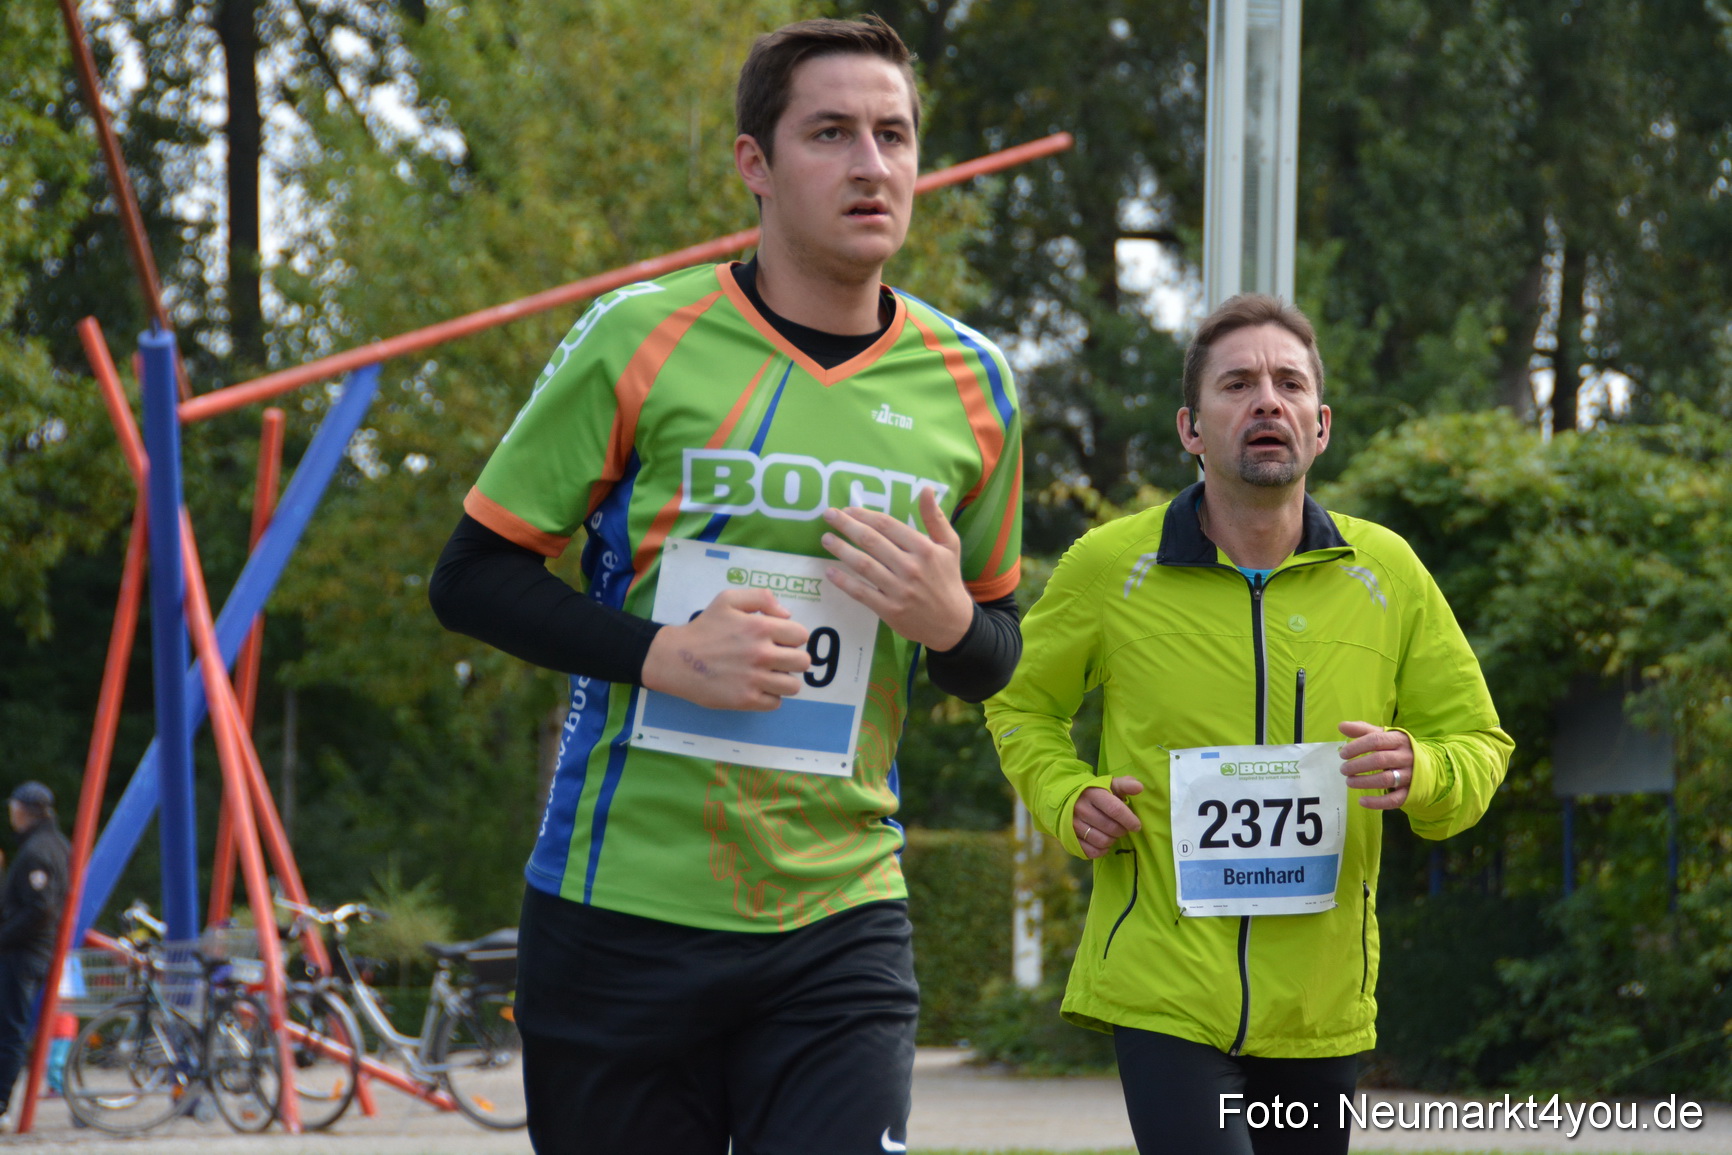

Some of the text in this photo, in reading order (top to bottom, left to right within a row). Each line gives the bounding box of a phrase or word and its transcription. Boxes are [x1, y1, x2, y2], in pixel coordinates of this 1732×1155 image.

[680, 448, 949, 536] BOCK
[749, 570, 822, 595] BOCK
[1238, 760, 1300, 776] BOCK
[1198, 797, 1323, 849] 2375
[1182, 844, 1189, 853] D
[1223, 866, 1305, 885] Bernhard
